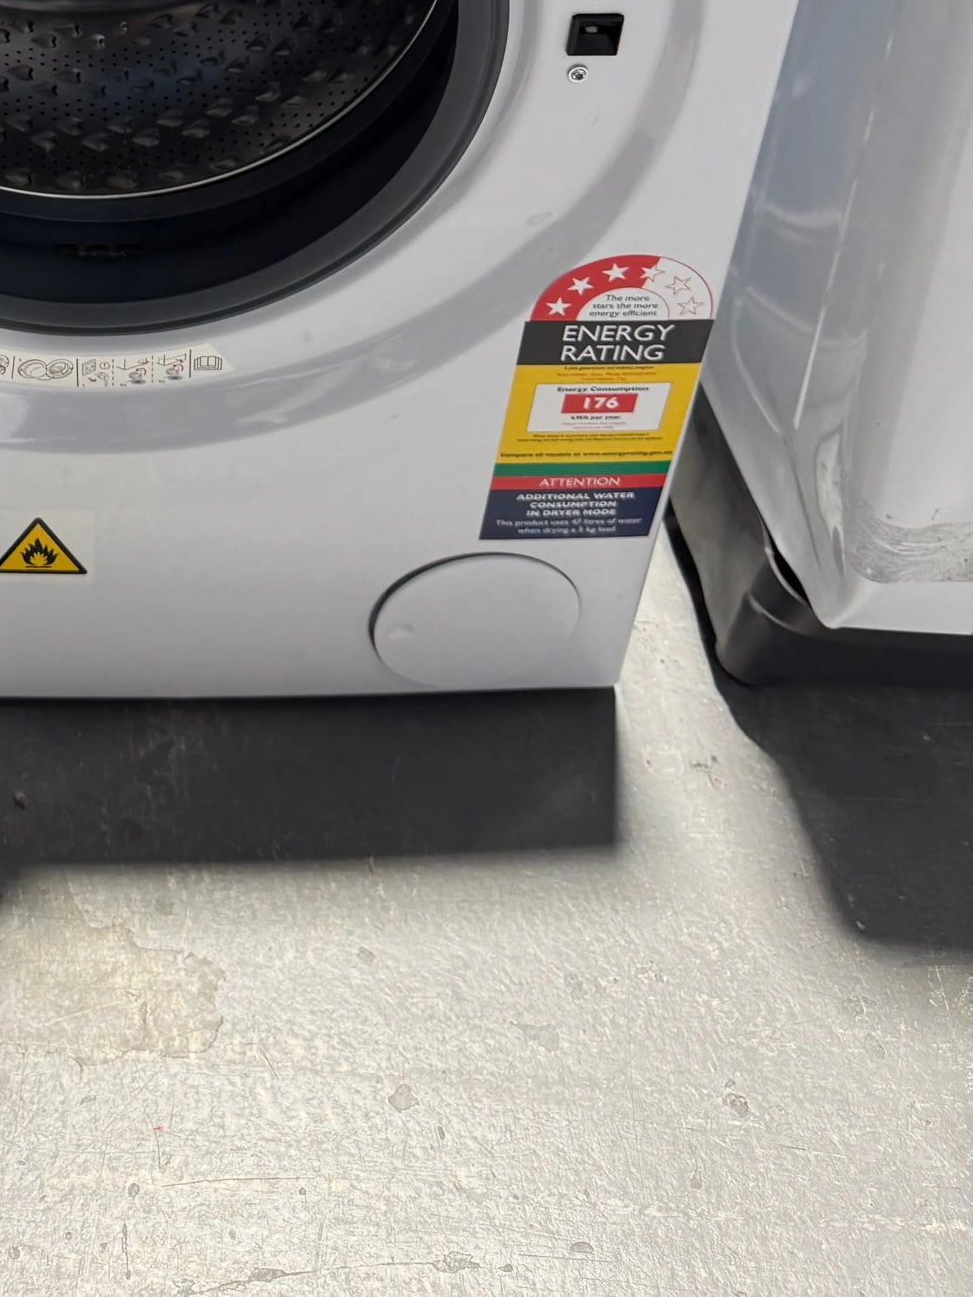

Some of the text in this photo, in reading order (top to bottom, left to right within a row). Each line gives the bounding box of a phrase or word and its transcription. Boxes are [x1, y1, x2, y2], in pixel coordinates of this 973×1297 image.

[606, 294, 623, 302] The
[562, 324, 676, 343] ENERGY
[560, 344, 666, 362] RATING
[583, 396, 619, 410] 176
[539, 477, 621, 487] ATTENTION
[516, 491, 635, 501] ADDITIONAL WATER
[529, 500, 618, 509] CONSUMPTION
[527, 508, 617, 517] IN DRYER MODE
